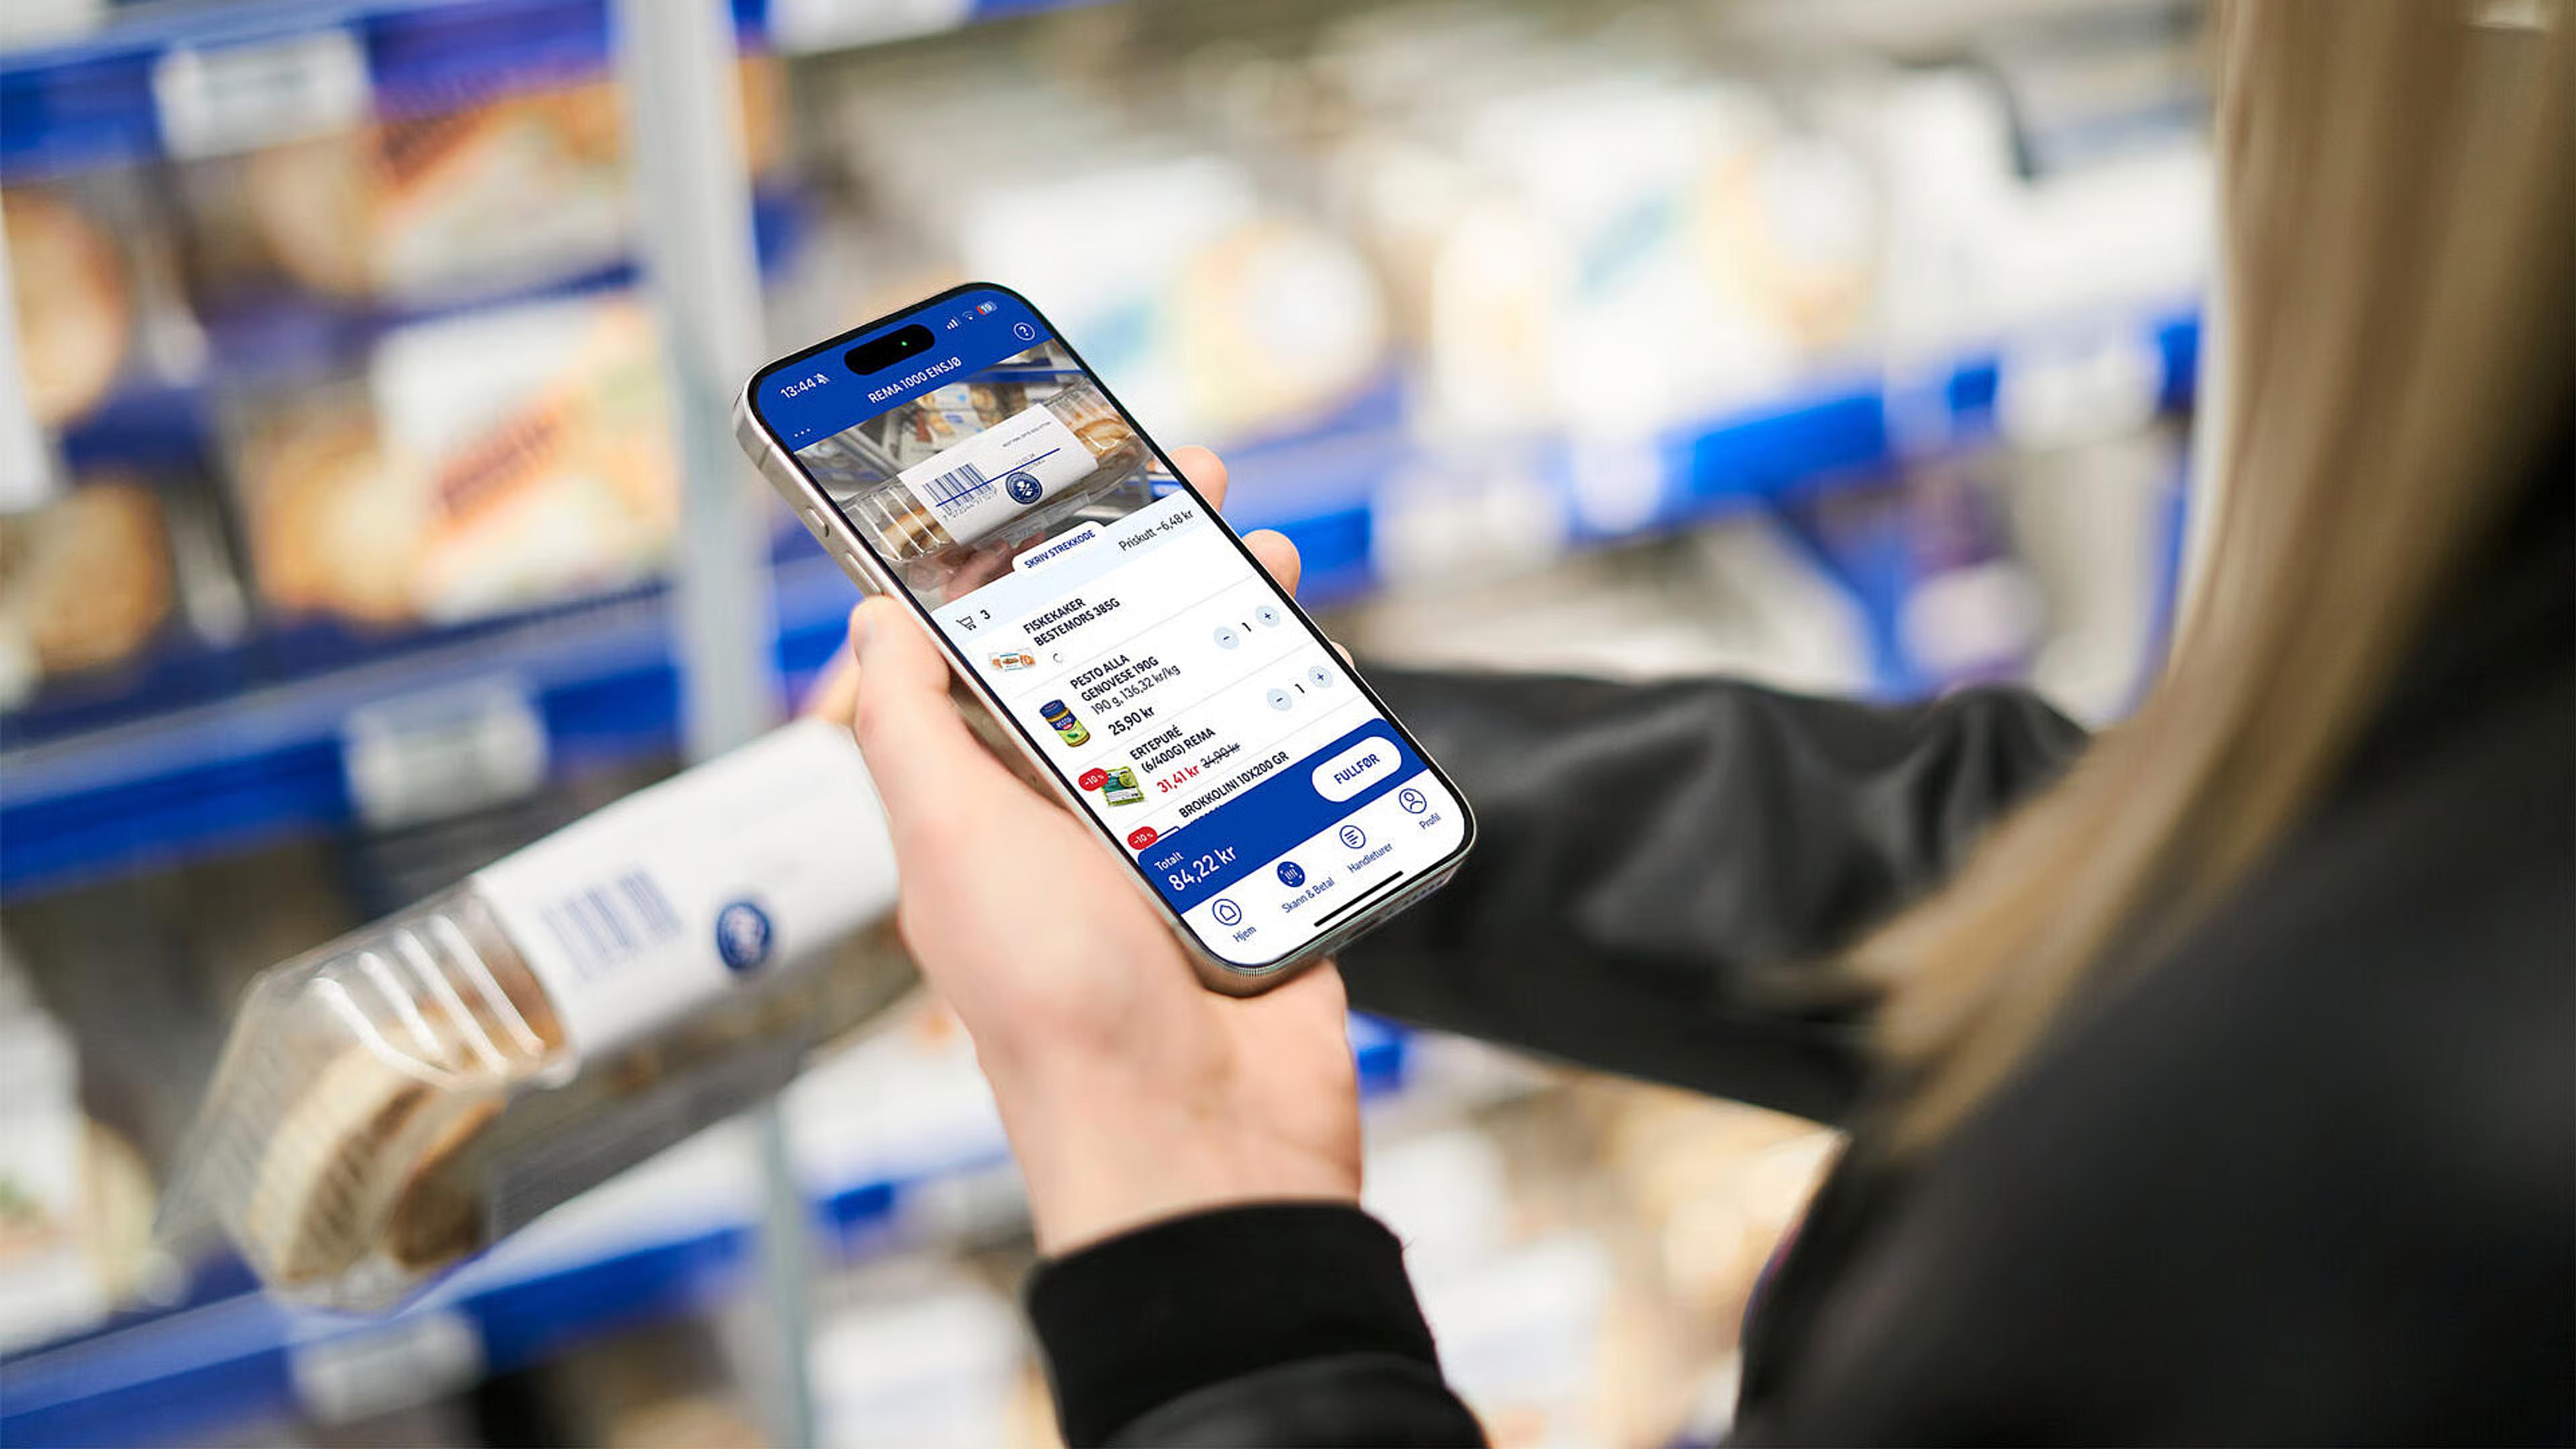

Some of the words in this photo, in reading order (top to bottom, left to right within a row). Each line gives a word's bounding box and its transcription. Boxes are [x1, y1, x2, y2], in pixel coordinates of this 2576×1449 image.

[781, 378, 816, 398] 13:44
[867, 383, 904, 403] REMA
[900, 372, 928, 388] 1000
[926, 356, 961, 378] ENSJØ
[1118, 528, 1157, 551] Priskutt
[1183, 509, 1194, 521] kr
[1024, 552, 1049, 568] SKRIV
[1048, 529, 1096, 557] STREKKODE
[980, 609, 991, 620] 3
[1023, 598, 1087, 634] FISKEKAKER
[1033, 610, 1095, 647] BESTEMORS
[1093, 598, 1120, 616] 385G
[1242, 623, 1251, 632] 1
[1070, 667, 1104, 689] PESTO
[1103, 654, 1130, 674] ALLA
[1081, 668, 1135, 701] GENOVESE
[1132, 656, 1159, 674] 190G
[1091, 699, 1112, 715] 190
[1120, 677, 1155, 700] 136,32
[1152, 665, 1181, 684] kr/kg
[1295, 684, 1305, 693] 1
[1108, 712, 1142, 736] 25,90
[1139, 706, 1155, 718] kr
[1130, 724, 1183, 760] ERTEPURÉ
[1141, 744, 1186, 773] (6/400G)
[1183, 728, 1216, 749] REMA
[1085, 775, 1098, 785] -10
[1157, 771, 1187, 793] 31,41
[1184, 765, 1200, 777] kr
[1179, 780, 1240, 818] BROKKOLINI
[1237, 760, 1273, 784] 10X200
[1272, 751, 1289, 765] GR
[1334, 753, 1381, 784] FULLFØR
[1419, 813, 1442, 830] Profil
[1134, 834, 1147, 844] -10
[1154, 851, 1184, 871] Totalt
[1169, 855, 1220, 891] 84,22
[1214, 847, 1236, 864] kr
[1347, 843, 1393, 873] Handleturer
[1281, 896, 1307, 913] Skann
[1305, 890, 1315, 899] &
[1312, 877, 1335, 895] Betal
[1233, 926, 1256, 942] Hjem
